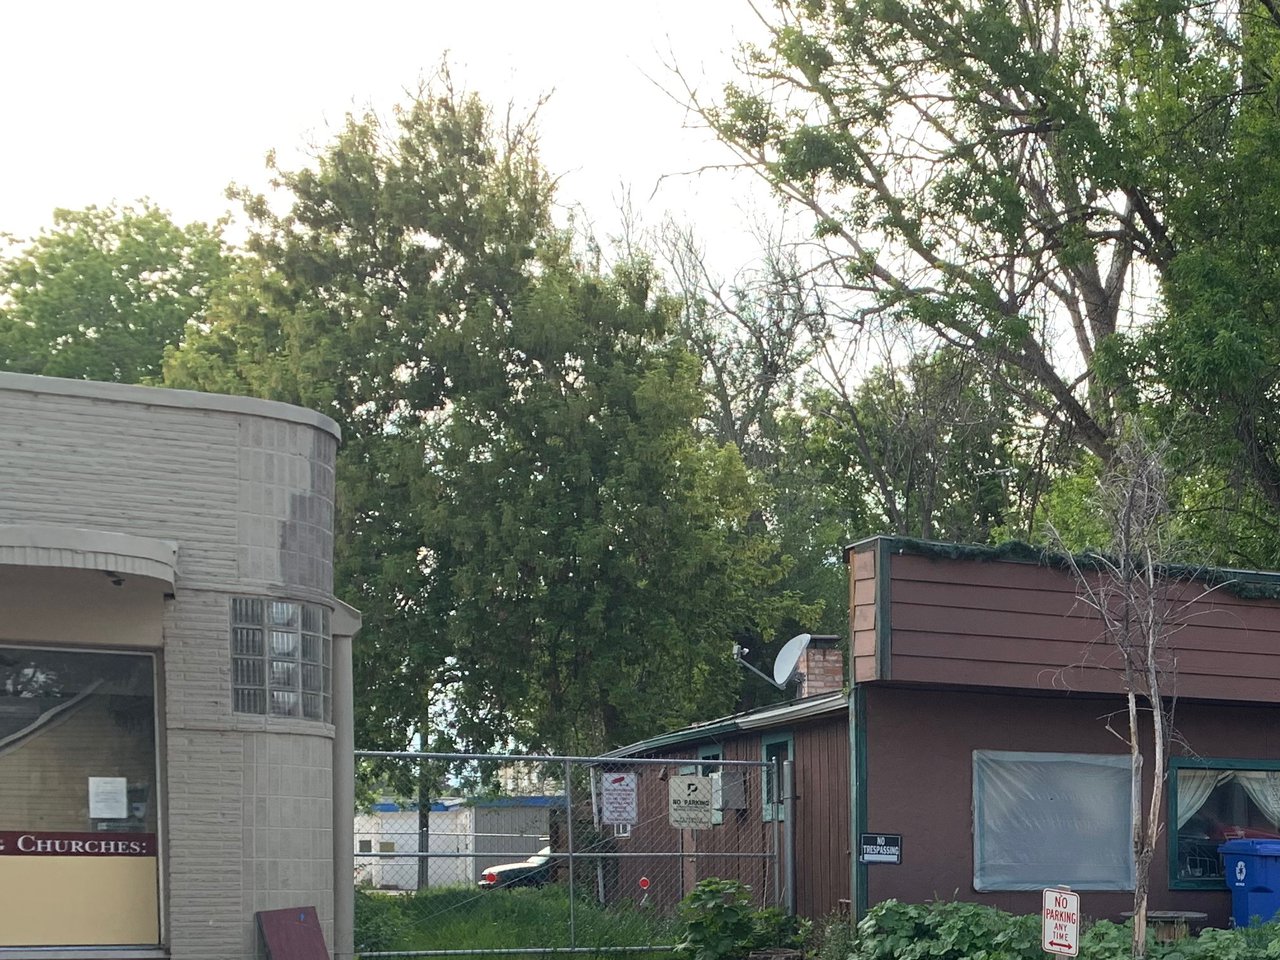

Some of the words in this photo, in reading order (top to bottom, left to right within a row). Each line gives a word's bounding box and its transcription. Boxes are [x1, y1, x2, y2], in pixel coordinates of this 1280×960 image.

[684, 799, 710, 807] PARKING
[877, 836, 886, 846] NO
[863, 845, 900, 855] TRESPASSING
[1054, 896, 1068, 909] NO
[1046, 908, 1076, 925] PARKING
[1054, 922, 1068, 932] ANY
[1053, 931, 1069, 942] TIME
